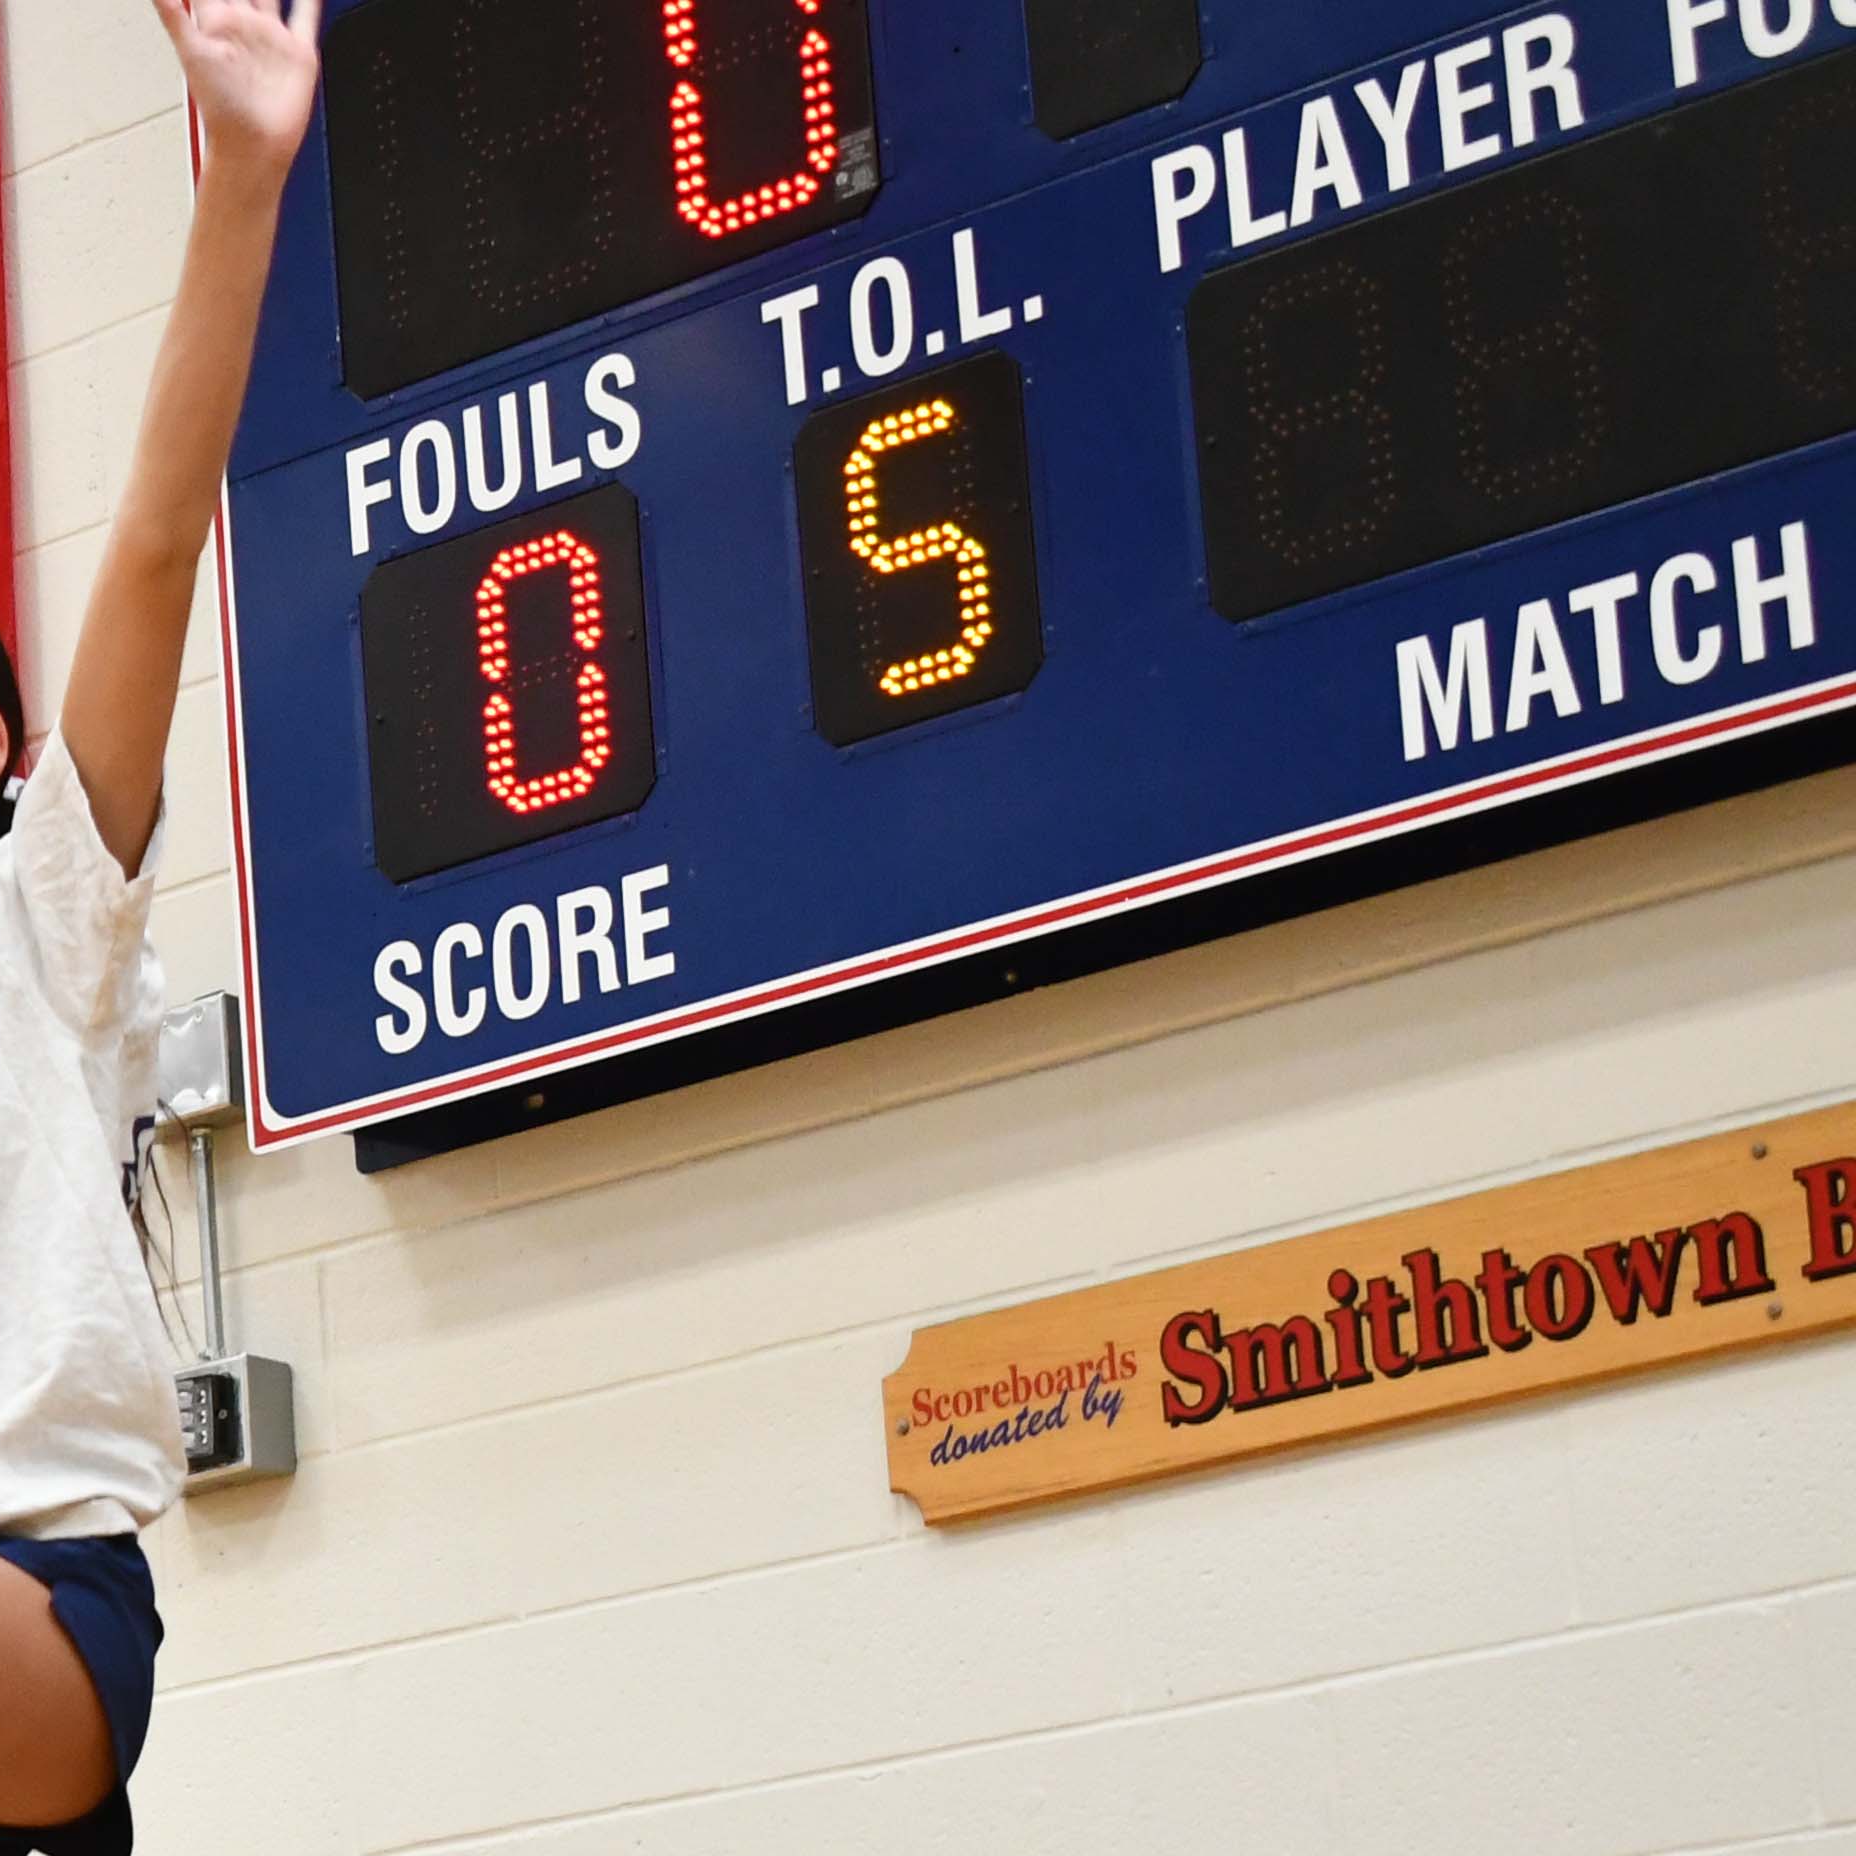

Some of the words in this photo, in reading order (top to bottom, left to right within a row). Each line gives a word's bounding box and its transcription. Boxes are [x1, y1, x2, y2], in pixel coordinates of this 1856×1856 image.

[1152, 15, 1585, 272] PLAYER
[761, 229, 1043, 405] T.O.L.
[345, 353, 642, 556] FOULS
[843, 395, 994, 697] 5
[473, 528, 613, 815] 0
[1396, 521, 1814, 761] MATCH
[373, 863, 675, 1054] SCORE
[912, 1340, 1138, 1429] Scoreboards
[929, 1387, 1071, 1467] donated
[1081, 1372, 1125, 1429] by
[1159, 1209, 1776, 1427] Smithtown
